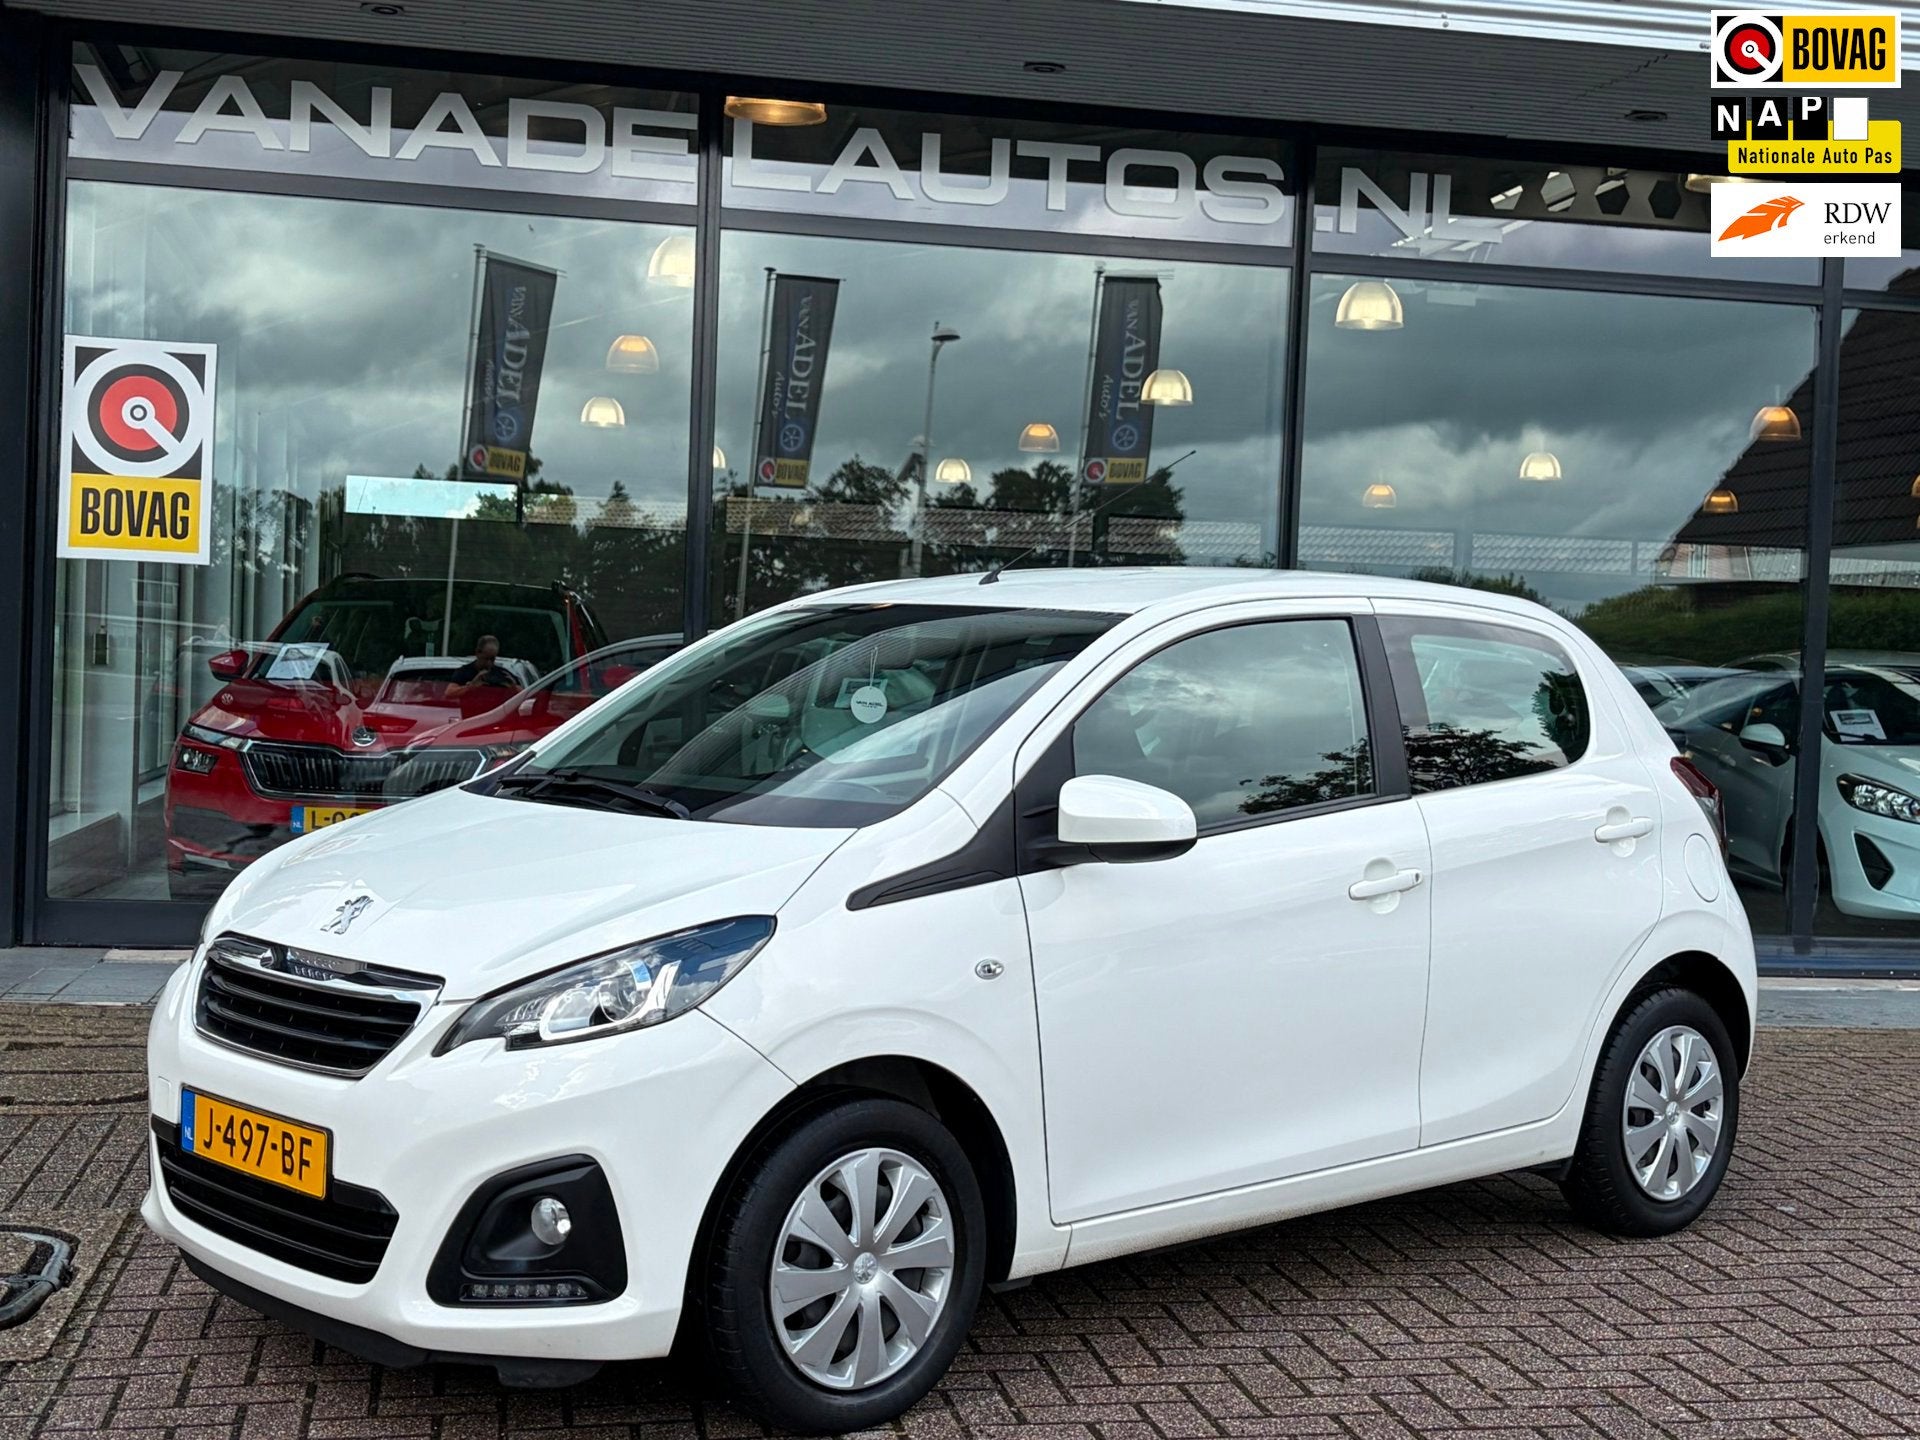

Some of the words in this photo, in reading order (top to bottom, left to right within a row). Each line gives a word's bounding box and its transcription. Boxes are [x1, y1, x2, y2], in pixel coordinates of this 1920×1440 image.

[785, 331, 817, 420] ADEL
[1115, 333, 1147, 421] ADEL
[80, 487, 190, 541] BOVAG
[184, 1125, 194, 1141] NL
[203, 1107, 313, 1181] J-497-BF
